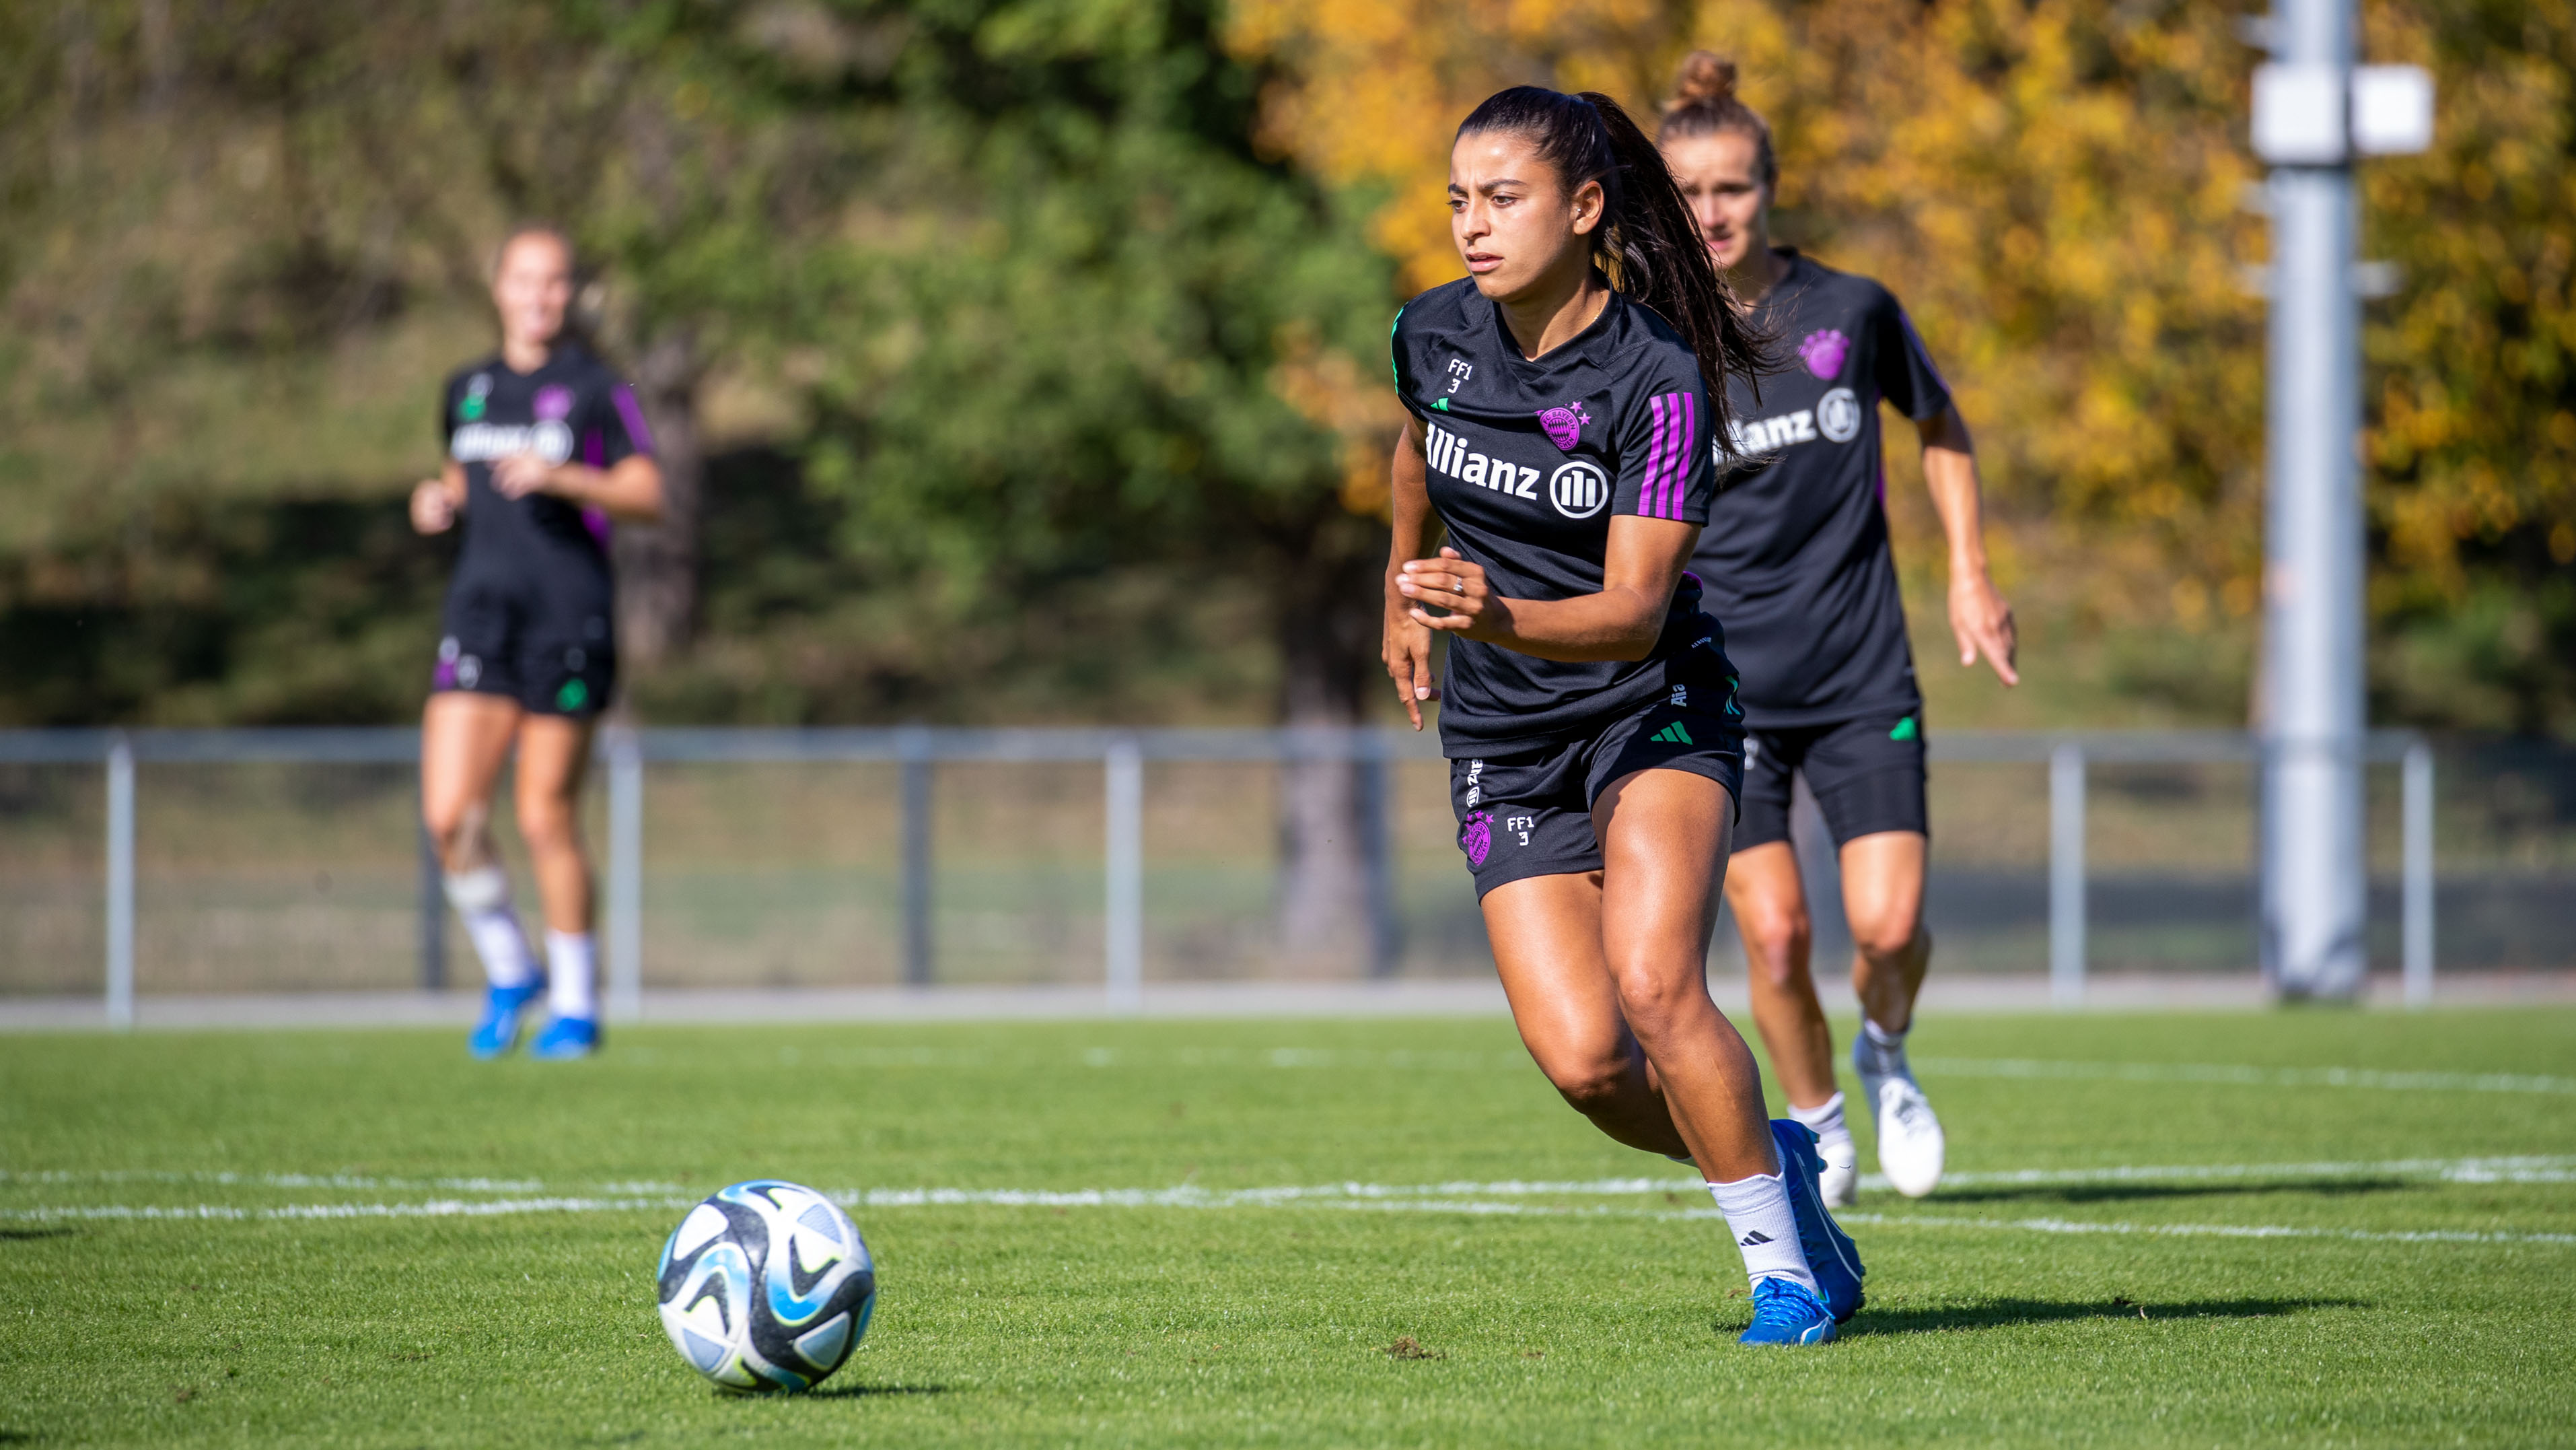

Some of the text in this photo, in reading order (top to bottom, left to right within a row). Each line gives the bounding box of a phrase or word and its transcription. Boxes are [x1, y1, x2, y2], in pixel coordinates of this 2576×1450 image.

[1447, 358, 1472, 380] FF1
[1447, 378, 1461, 394] 3
[1552, 411, 1575, 429] BAYERN
[1507, 816, 1534, 831] FF1
[1518, 831, 1529, 846] 3
